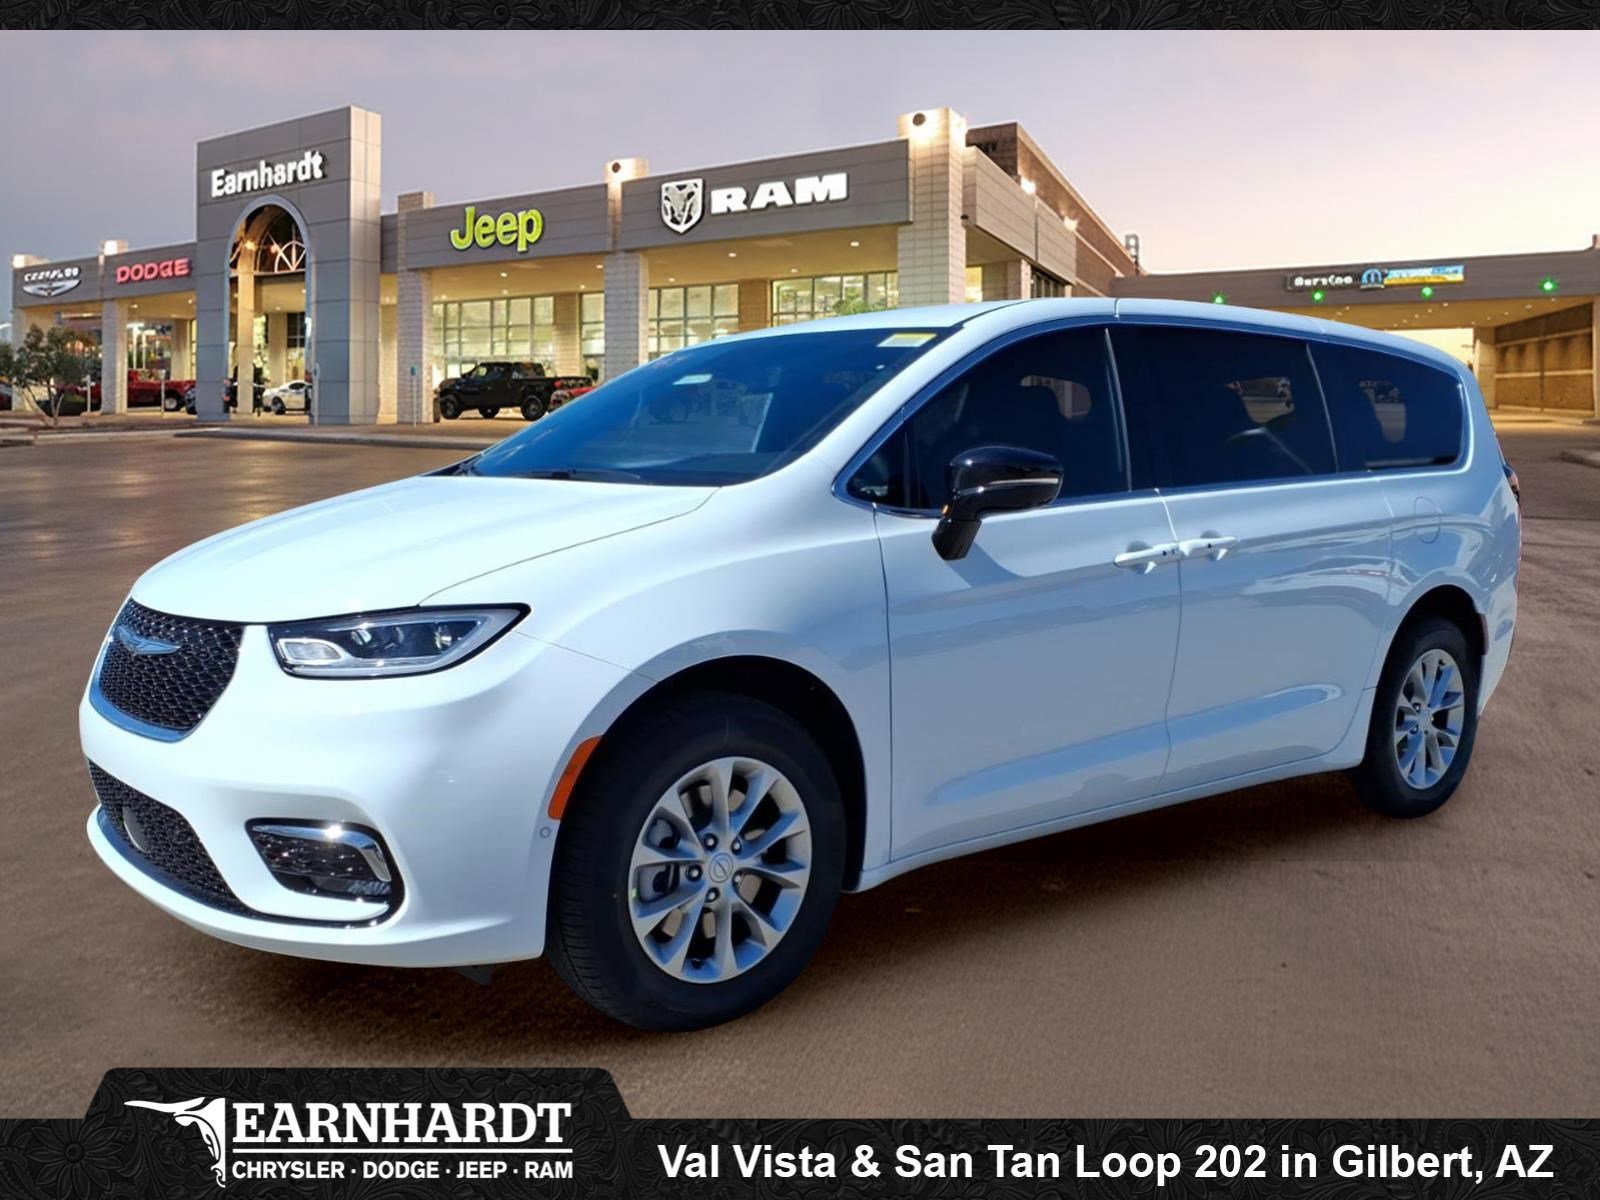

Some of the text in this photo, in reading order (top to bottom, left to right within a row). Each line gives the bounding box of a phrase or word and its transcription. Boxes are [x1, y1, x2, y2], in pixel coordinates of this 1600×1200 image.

[211, 151, 323, 197] Earnhardt
[711, 172, 848, 215] RAM
[450, 206, 543, 252] Jeep
[116, 258, 190, 284] DODGE
